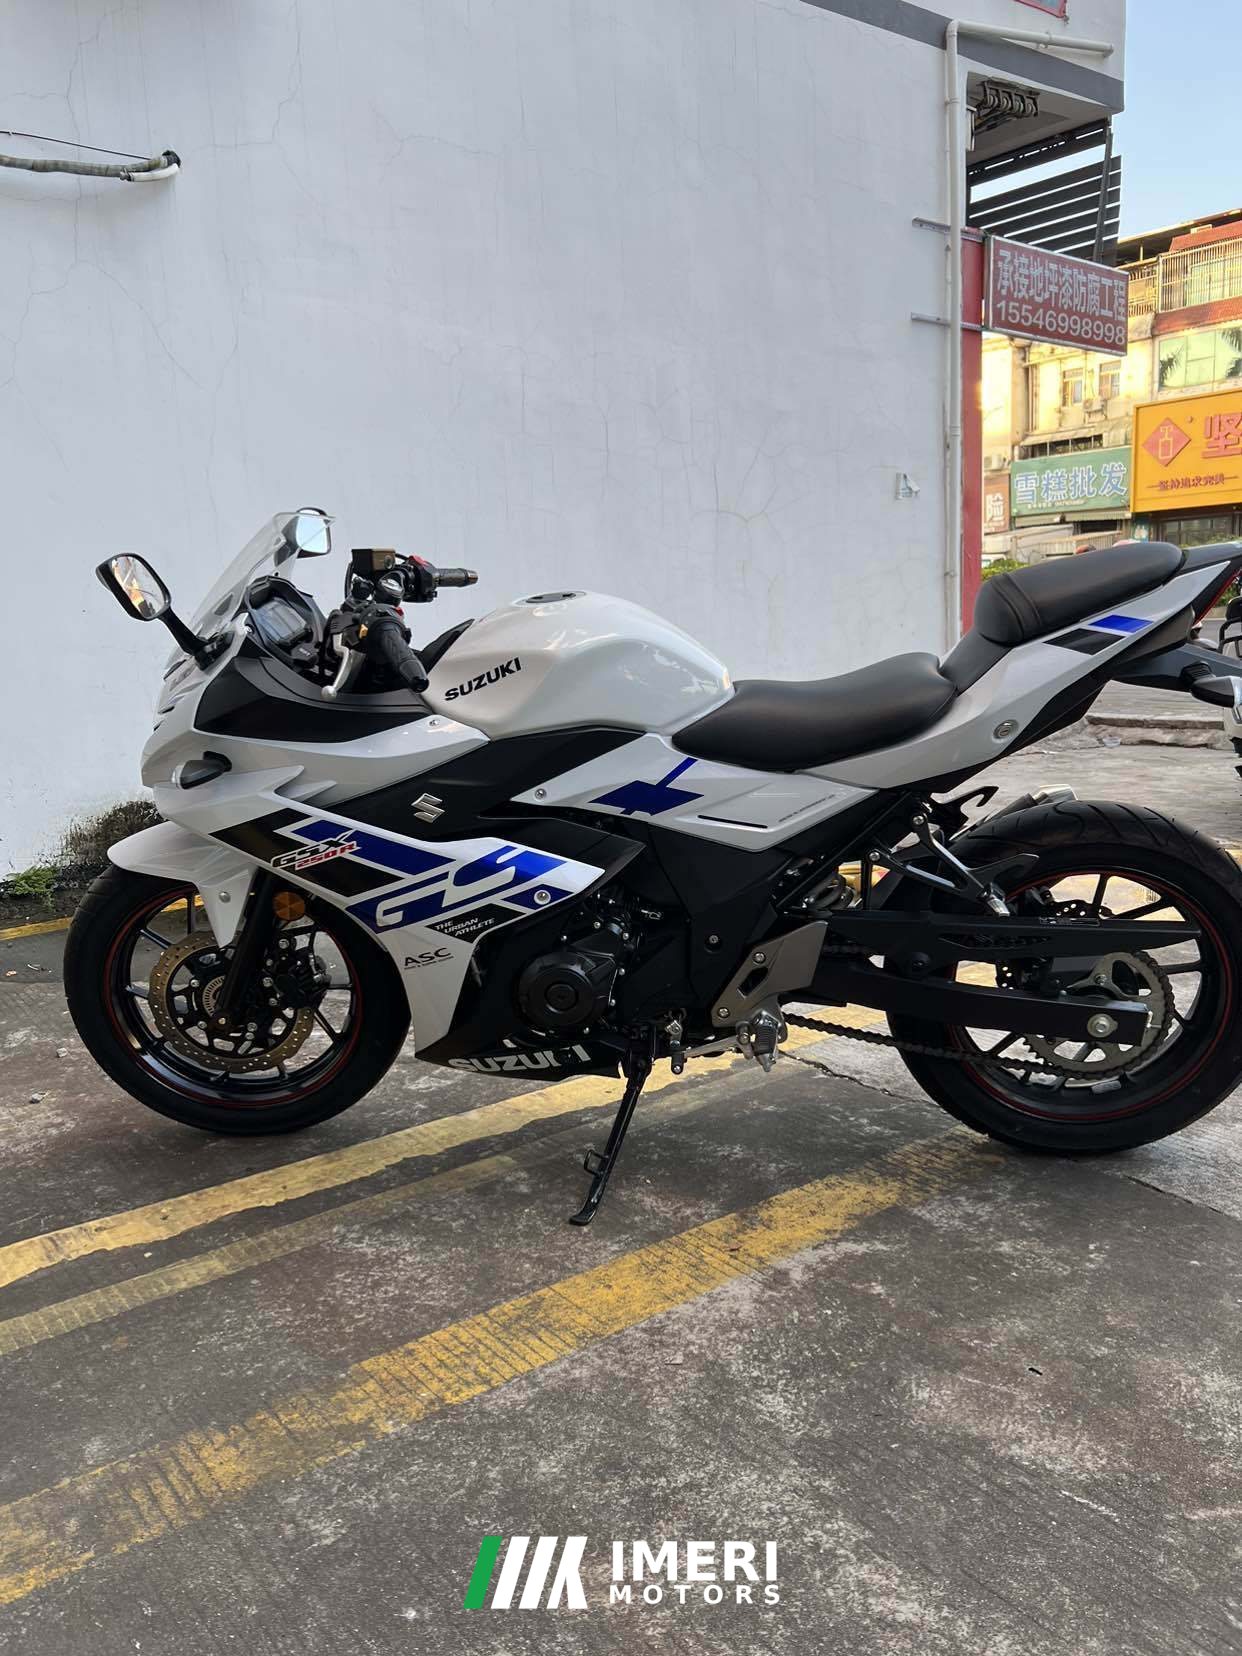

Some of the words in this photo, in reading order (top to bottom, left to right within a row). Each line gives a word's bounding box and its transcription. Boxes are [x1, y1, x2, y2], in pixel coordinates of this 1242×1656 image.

[998, 249, 1126, 321] 承接地坪漆防腐工程
[996, 300, 1126, 345] 15546998998
[1015, 462, 1127, 505] 雪糕批发
[445, 657, 522, 701] SUZUKI
[271, 829, 355, 868] GSX
[295, 841, 361, 870] 250R
[435, 920, 454, 931] THE
[444, 918, 479, 934] URBAN
[454, 918, 495, 937] ATHLETE
[404, 947, 451, 967] ASC
